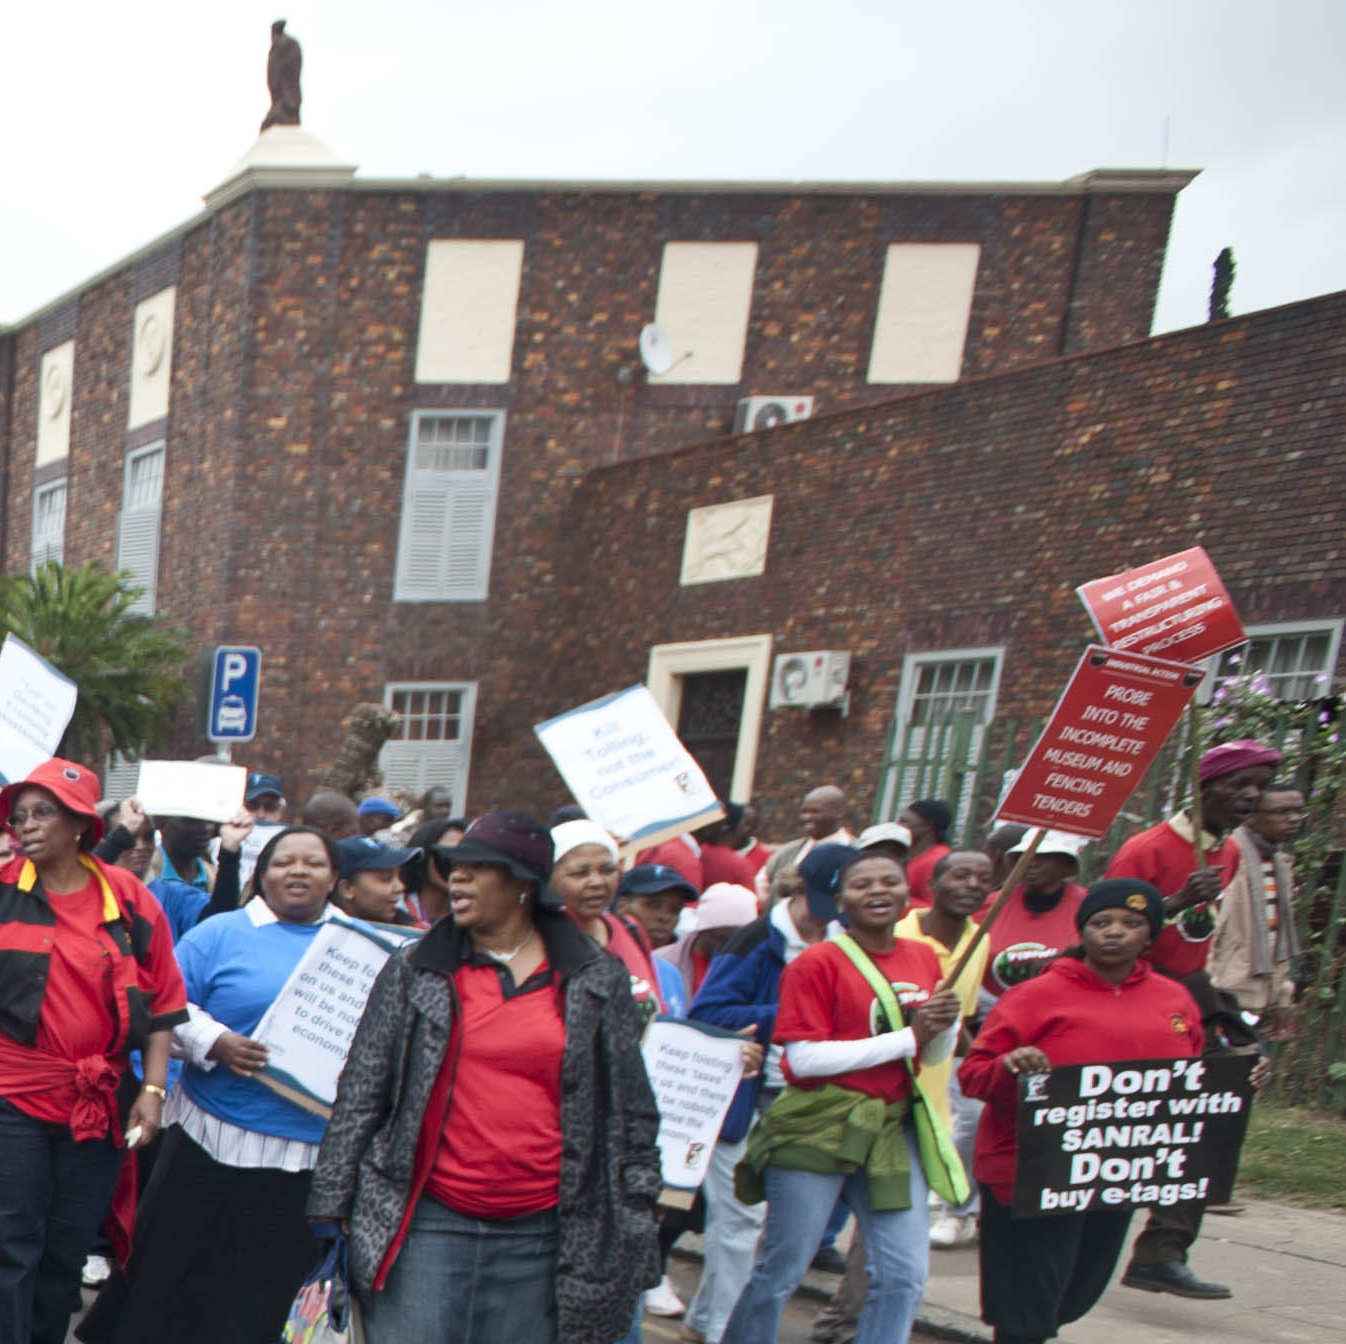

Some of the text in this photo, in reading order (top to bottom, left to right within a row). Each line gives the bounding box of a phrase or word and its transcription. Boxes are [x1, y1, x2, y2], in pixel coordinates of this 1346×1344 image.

[1109, 583, 1207, 633] TRANSPARENT
[1122, 599, 1135, 611] A
[1133, 584, 1168, 605] FAIR
[1143, 621, 1207, 654] PROCESS
[222, 653, 248, 691] P
[1104, 684, 1154, 706] PROBE
[1081, 705, 1151, 731] INTO THE
[1059, 726, 1147, 756] INCOMPLETE
[1043, 747, 1133, 777] MUSEUM AND
[1044, 773, 1106, 797] FENCING
[1031, 794, 1094, 818] TENDERS
[325, 945, 360, 971] Keep
[318, 961, 355, 986] these
[293, 987, 318, 1005] will
[318, 998, 335, 1014] be
[300, 972, 365, 1011] on us and
[295, 1004, 309, 1019] to
[311, 1012, 344, 1037] drive
[656, 1059, 688, 1076] these
[660, 1043, 733, 1073] Keep foisting
[659, 1078, 674, 1089] us
[677, 1082, 699, 1096] and
[699, 1086, 728, 1103] there
[1079, 1060, 1206, 1098] Don't
[662, 1093, 719, 1119] be nobody
[1033, 1091, 1244, 1128] register with
[685, 1115, 705, 1129] the
[1061, 1121, 1205, 1152] SANRAL!
[1069, 1147, 1188, 1185] Don't
[1040, 1177, 1210, 1212] buy e-tags!
